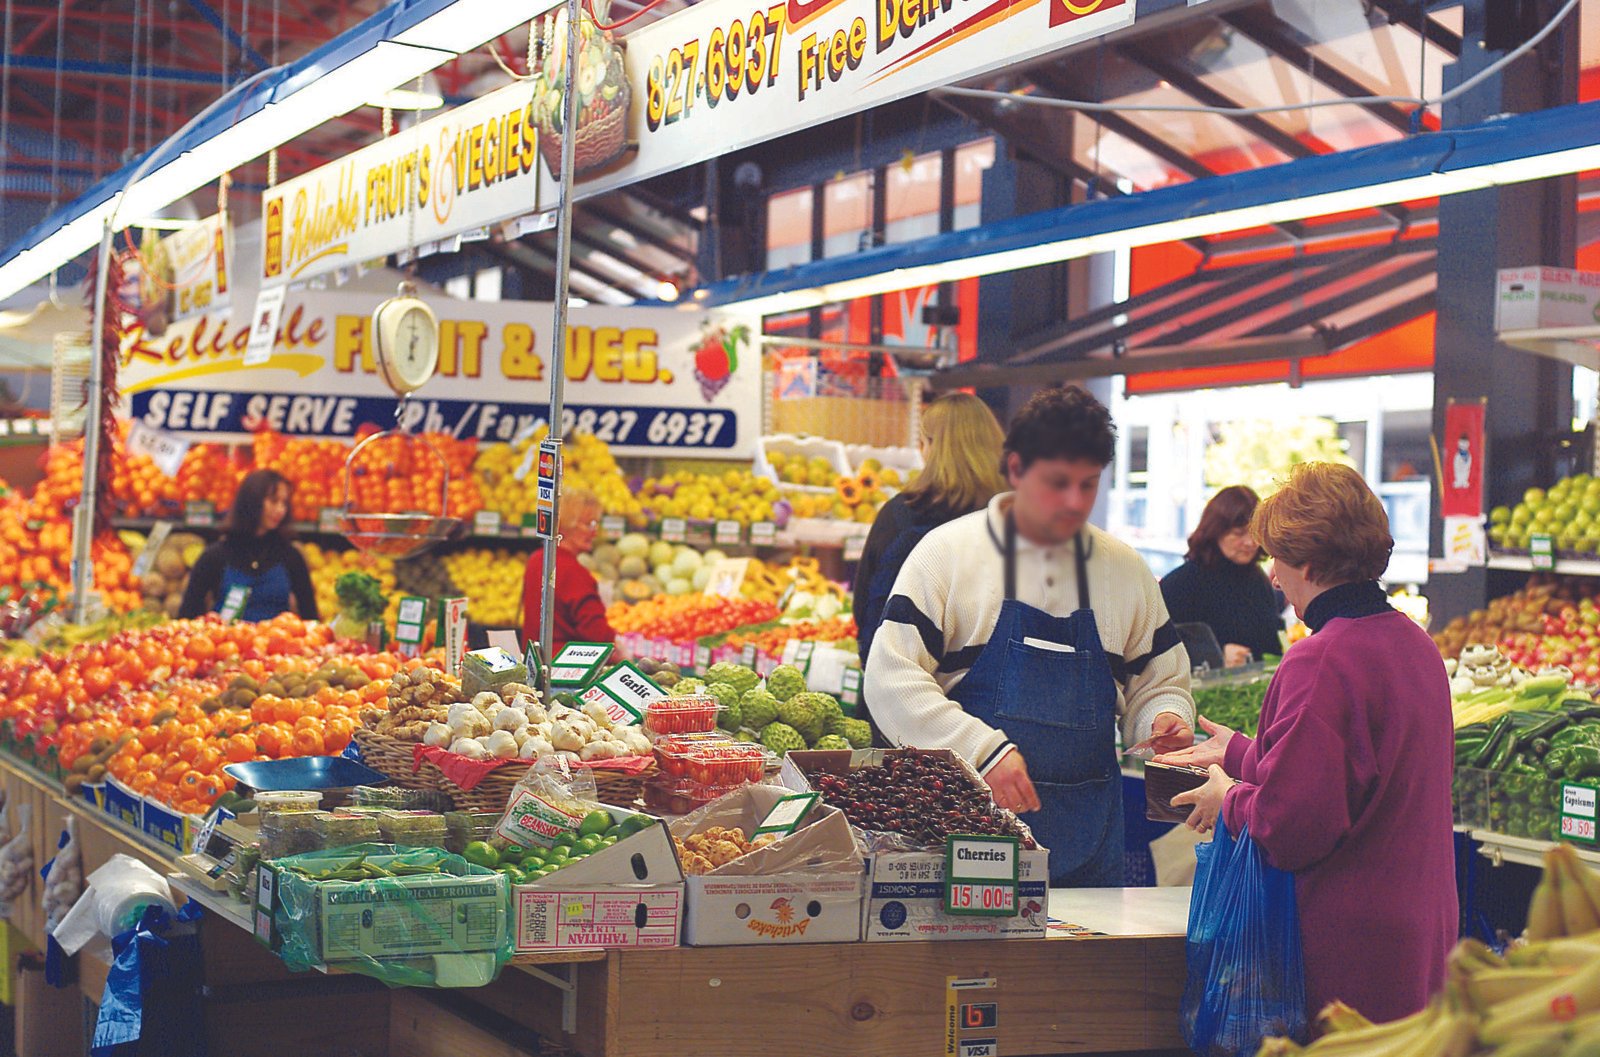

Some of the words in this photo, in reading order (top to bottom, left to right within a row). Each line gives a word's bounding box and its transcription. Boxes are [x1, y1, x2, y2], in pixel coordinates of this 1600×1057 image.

[799, 16, 866, 102] Free
[287, 160, 361, 268] Reliable
[456, 103, 538, 195] VEGIES
[119, 304, 326, 368] Reliale
[501, 322, 543, 380] &
[144, 391, 232, 431] SELF
[243, 395, 357, 433] SERVE
[648, 412, 726, 447] 6937
[619, 673, 651, 699] Garlic
[957, 847, 1006, 862] Cherries
[443, 885, 496, 898] PRODUCE
[879, 885, 916, 896] SNOKIST
[567, 932, 629, 945] TAHITIAN
[581, 926, 616, 934] LIMES
[747, 917, 811, 939] Artichokes
[947, 1004, 956, 1054] Welcome
[967, 1046, 990, 1057] VISA
